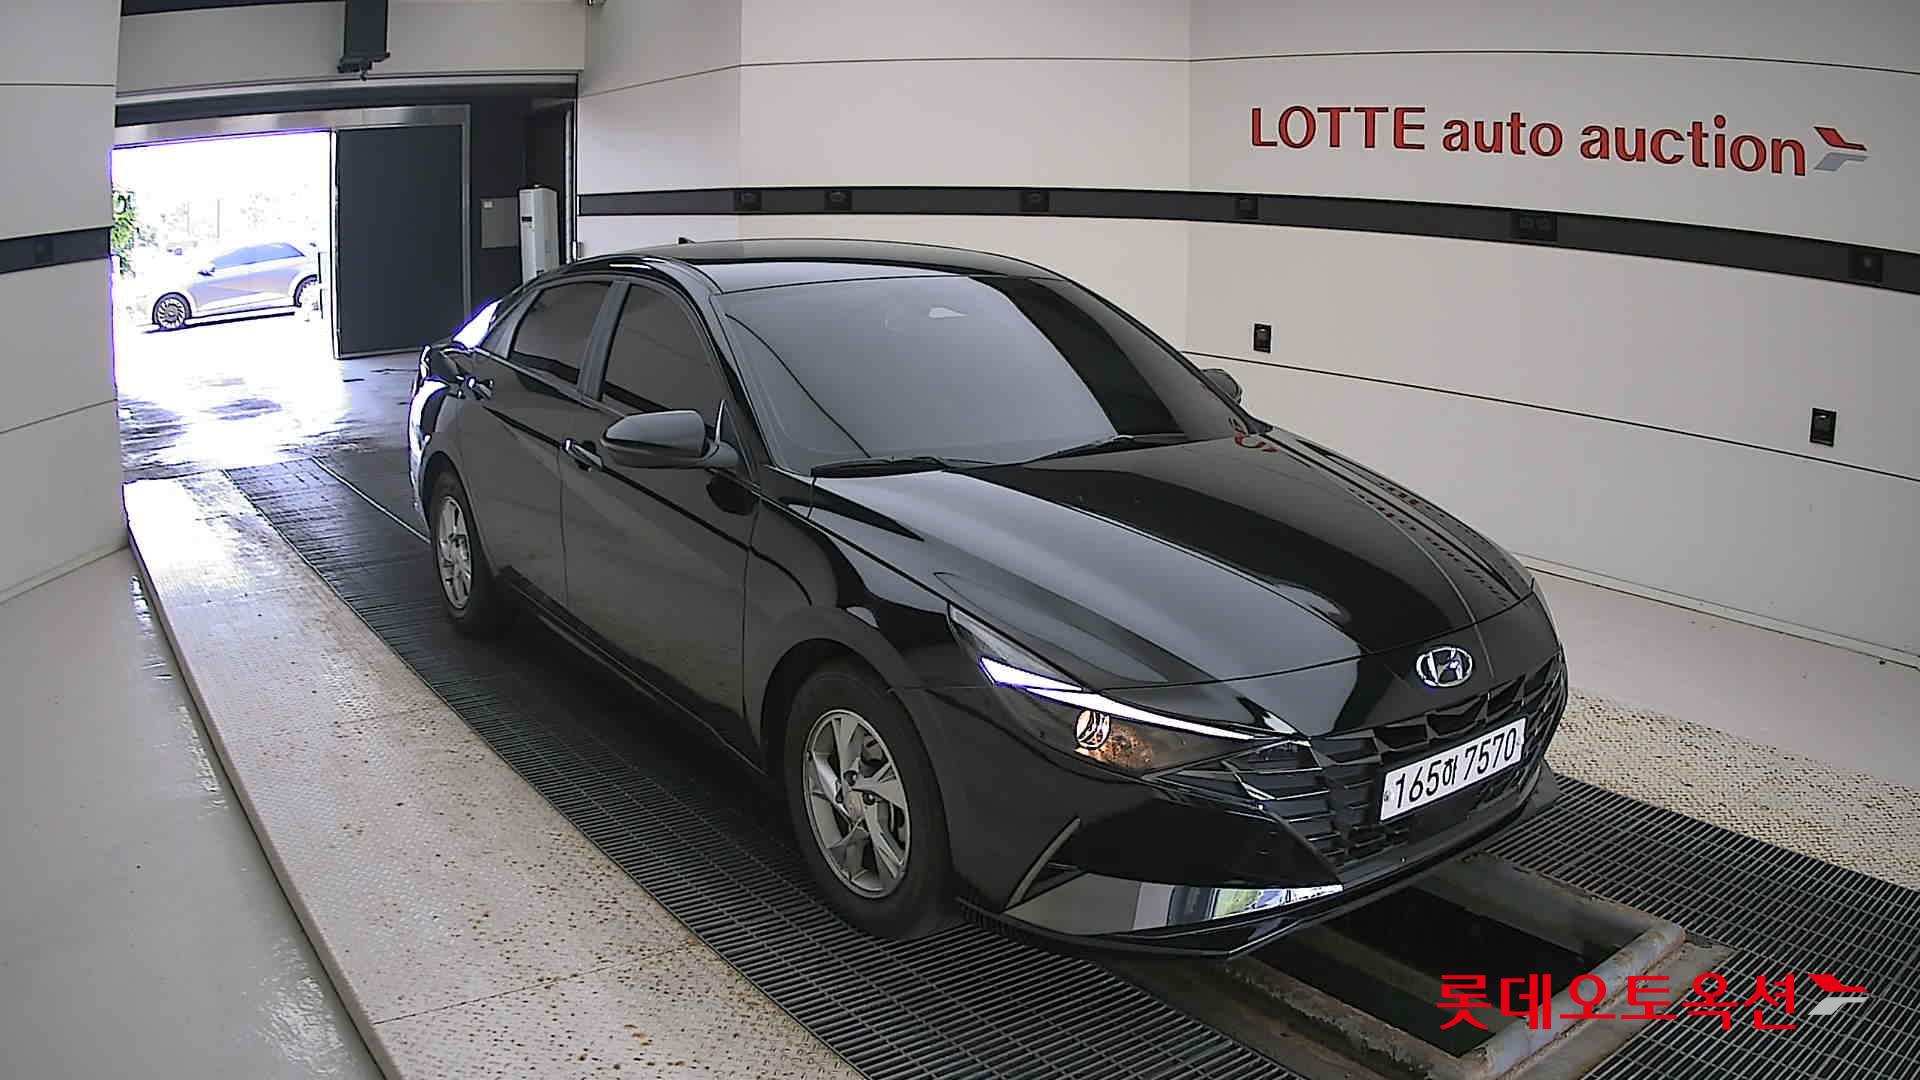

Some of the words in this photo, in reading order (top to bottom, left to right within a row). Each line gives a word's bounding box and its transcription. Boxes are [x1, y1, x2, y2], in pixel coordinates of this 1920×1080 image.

[1250, 106, 1426, 150] LOTTE
[1442, 112, 1563, 157] auto
[1580, 114, 1806, 175] auction
[1394, 755, 1458, 809] 165하
[1463, 727, 1517, 781] 7570
